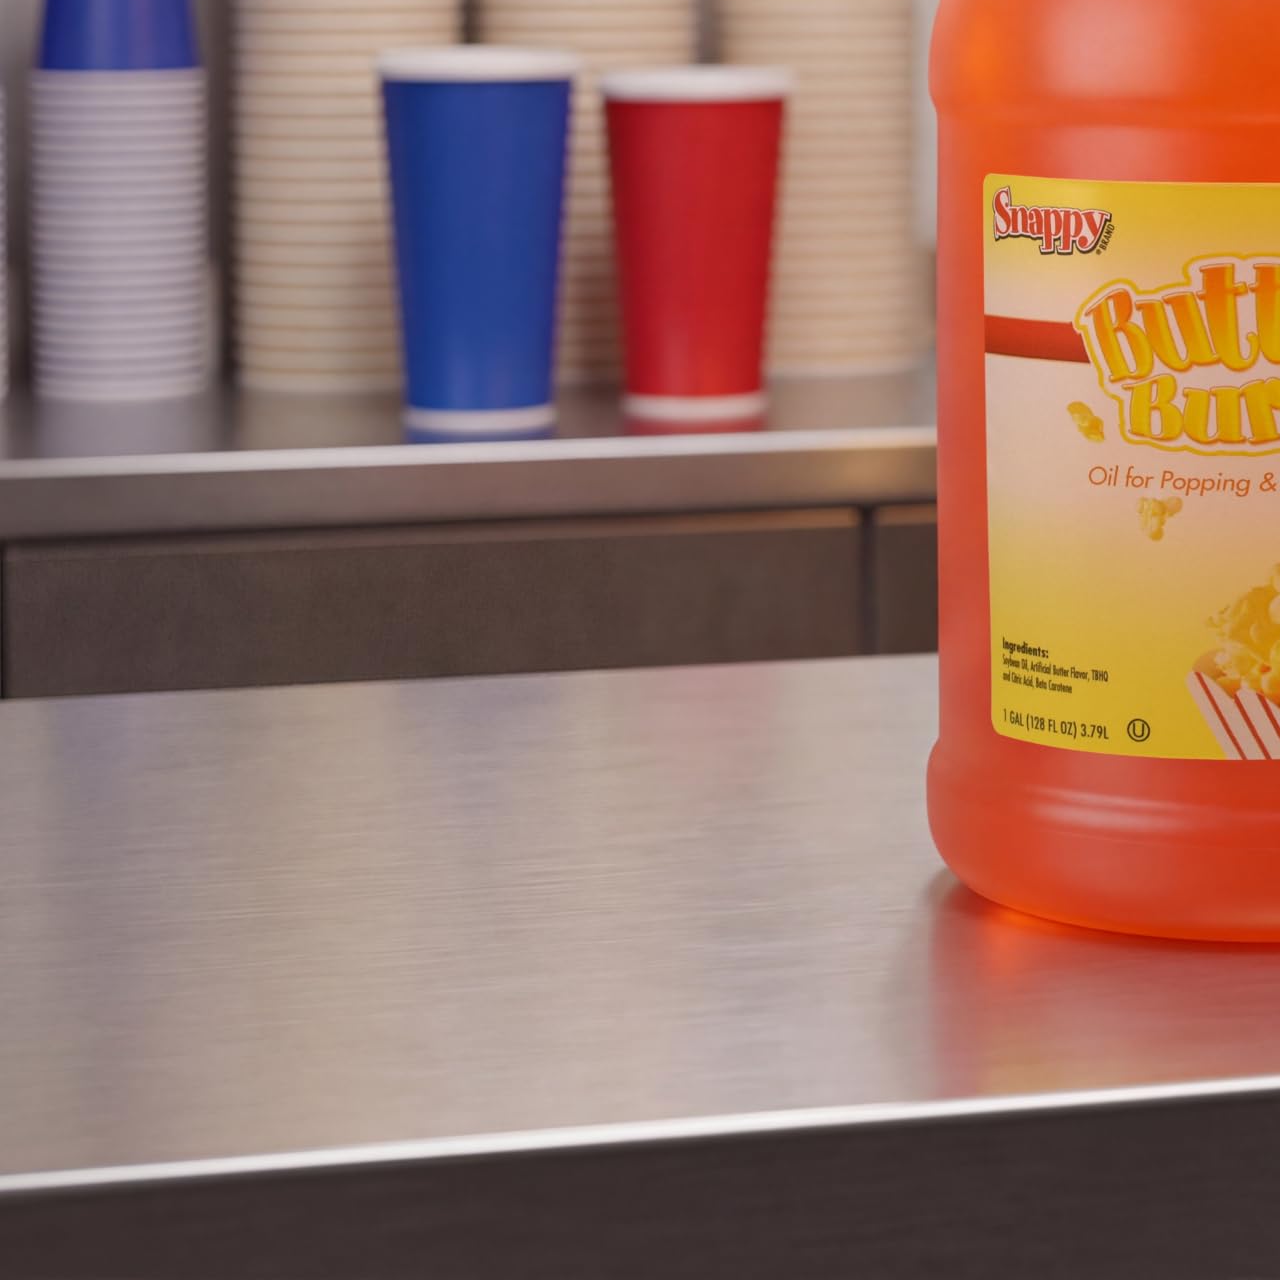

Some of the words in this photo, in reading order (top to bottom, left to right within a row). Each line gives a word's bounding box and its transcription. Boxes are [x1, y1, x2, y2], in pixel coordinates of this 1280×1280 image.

[992, 186, 1112, 255] Snappy
[1099, 223, 1115, 250] BRAND
[1088, 465, 1118, 487] Oil
[1125, 466, 1154, 488] for
[1160, 471, 1250, 496] Popping
[1259, 472, 1278, 492] &
[1002, 637, 1049, 659] Ingredients:
[1036, 678, 1047, 690] Beta
[1048, 680, 1072, 693] Carotene
[1053, 665, 1069, 678] Butter
[1091, 669, 1108, 682] TBHQ
[1009, 711, 1024, 727] GAL
[1026, 713, 1045, 731] (128
[1048, 719, 1058, 734] FL
[1060, 721, 1077, 739] OZ)
[1081, 724, 1109, 740] 3.79L
